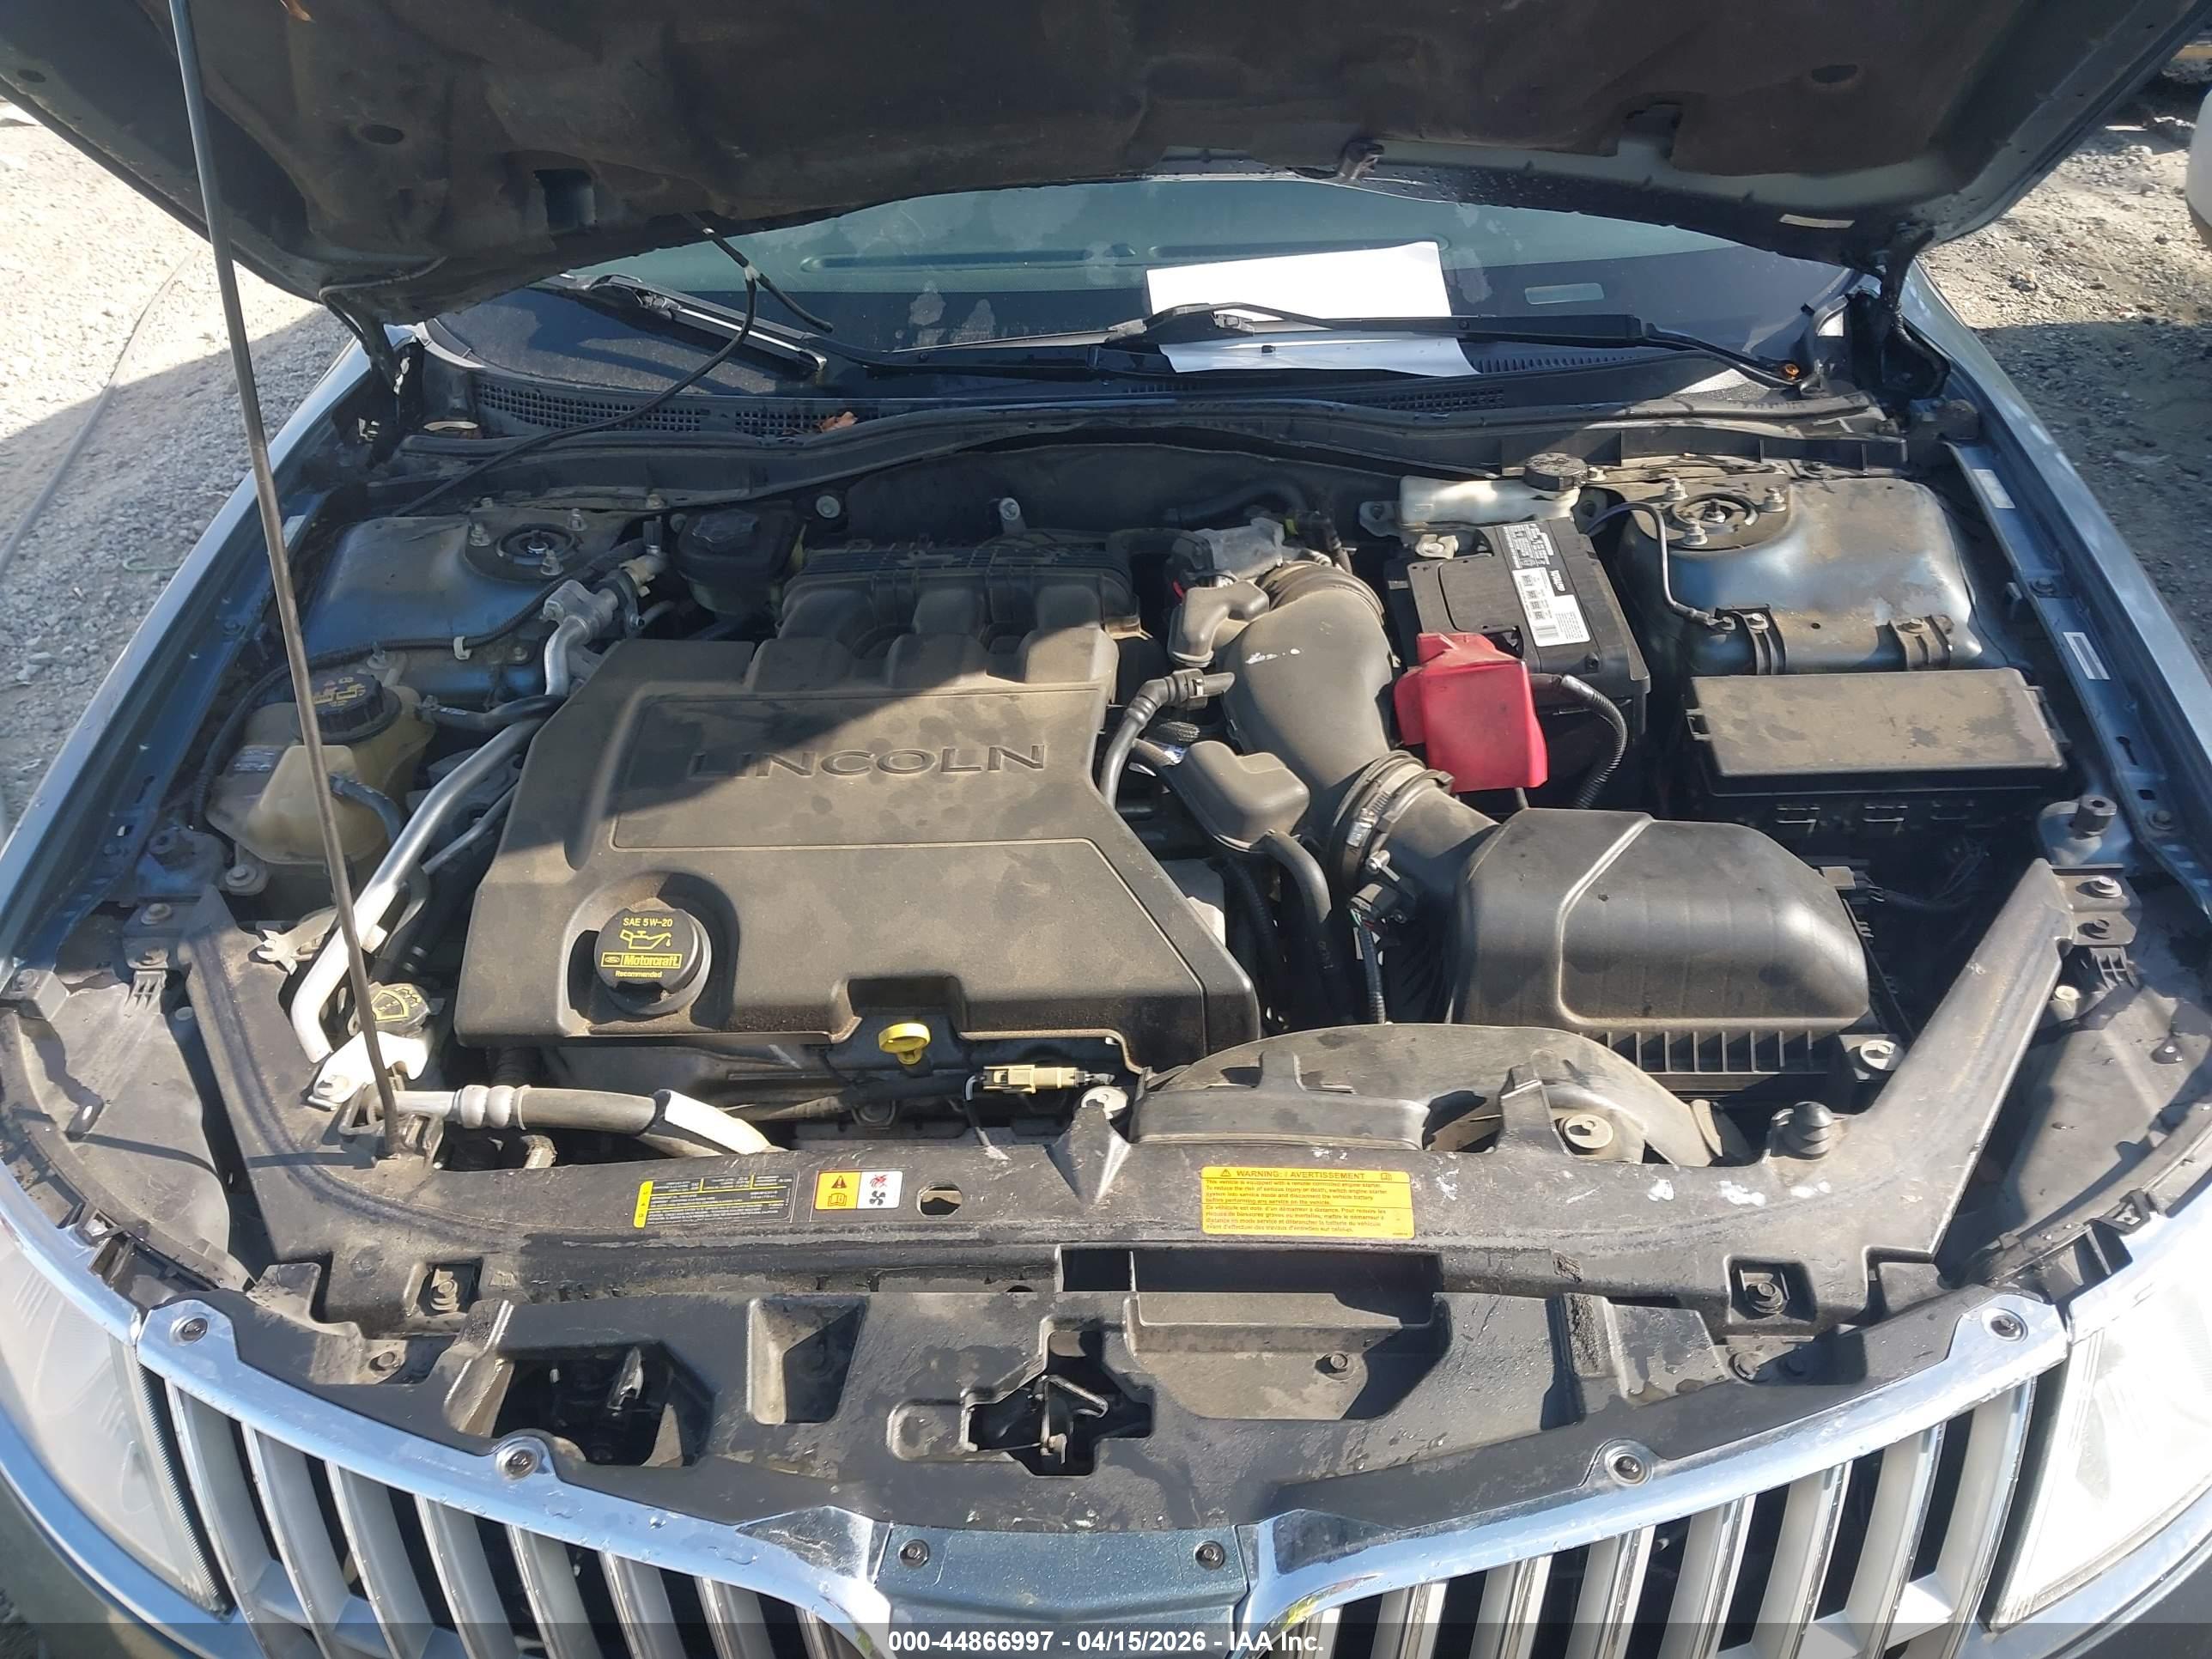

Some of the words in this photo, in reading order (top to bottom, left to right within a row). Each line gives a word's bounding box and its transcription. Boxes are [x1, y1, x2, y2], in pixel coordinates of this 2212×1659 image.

[690, 744, 1045, 778] LINCOLN
[623, 918, 641, 927] SAE
[642, 918, 673, 927] 5W-20
[623, 955, 679, 967] Motorcraft
[1291, 1171, 1365, 1180] AVERTISSEMENT
